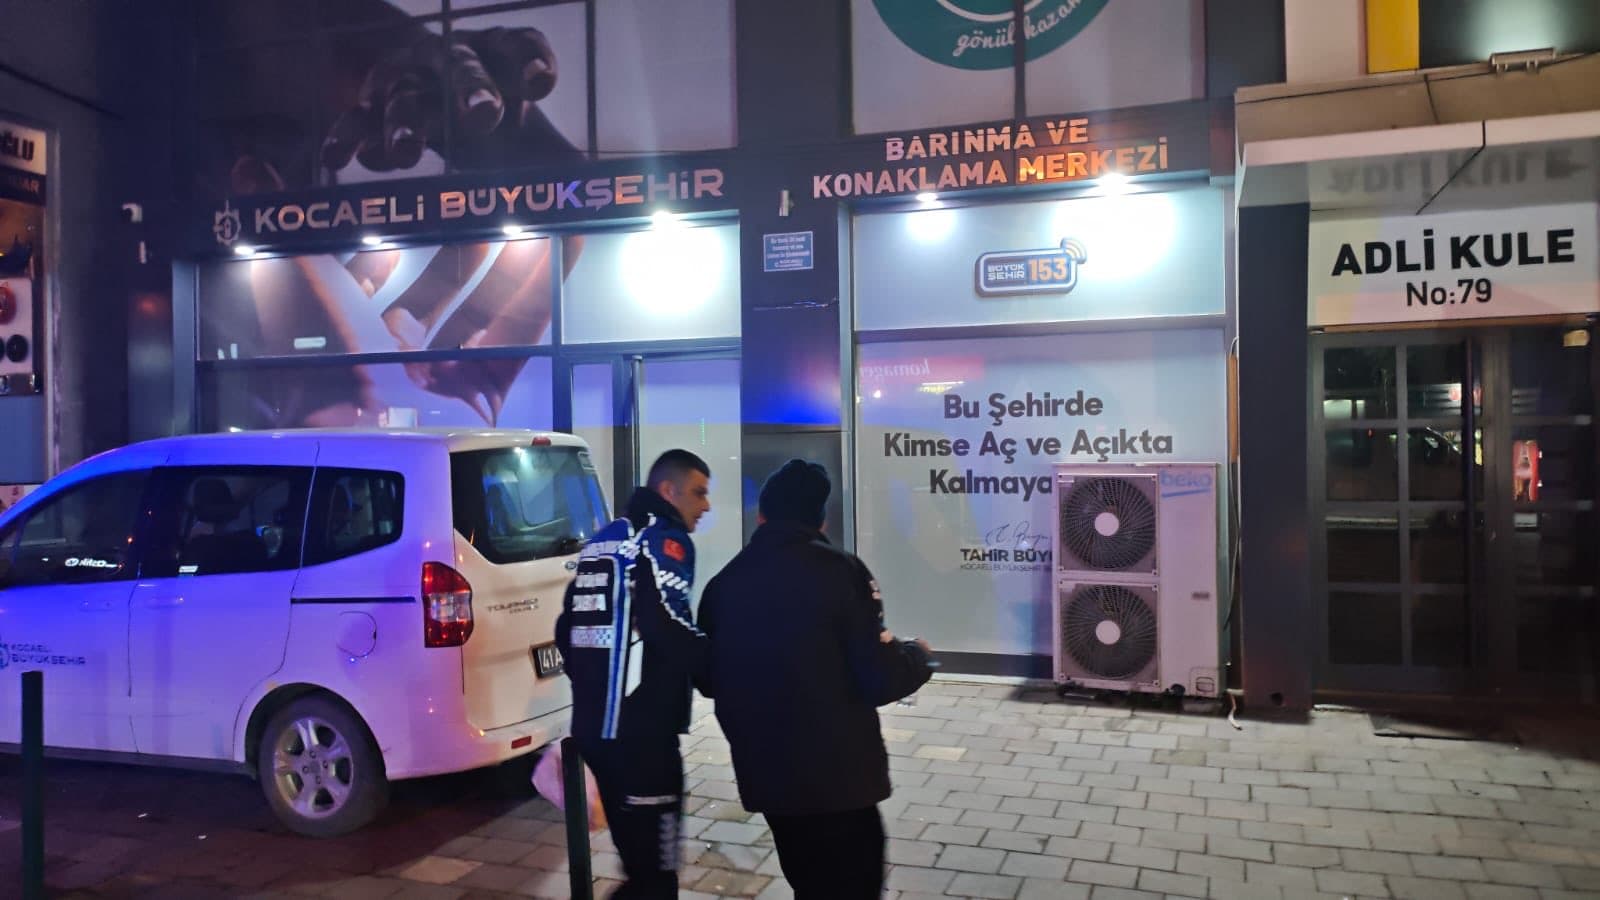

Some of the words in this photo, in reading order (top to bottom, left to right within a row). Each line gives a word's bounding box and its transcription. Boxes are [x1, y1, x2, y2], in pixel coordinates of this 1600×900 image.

[953, 21, 1016, 57] gönül
[886, 125, 1037, 162] BARINMA
[1046, 118, 1089, 145] VE
[813, 159, 1008, 199] KONAKLAMA
[1018, 136, 1168, 182] MERKEZİ
[1028, 258, 1067, 280] 153
[1331, 228, 1435, 277] ADLİ
[1450, 228, 1575, 270] KULE
[1406, 277, 1493, 307] No:79
[944, 394, 980, 418] Bu
[988, 390, 1104, 426] Şehirde
[884, 432, 970, 457] Kimse
[979, 430, 1017, 464] Aç
[1026, 437, 1061, 456] ve
[1070, 428, 1173, 463] Açıkta
[1160, 471, 1212, 487] beko
